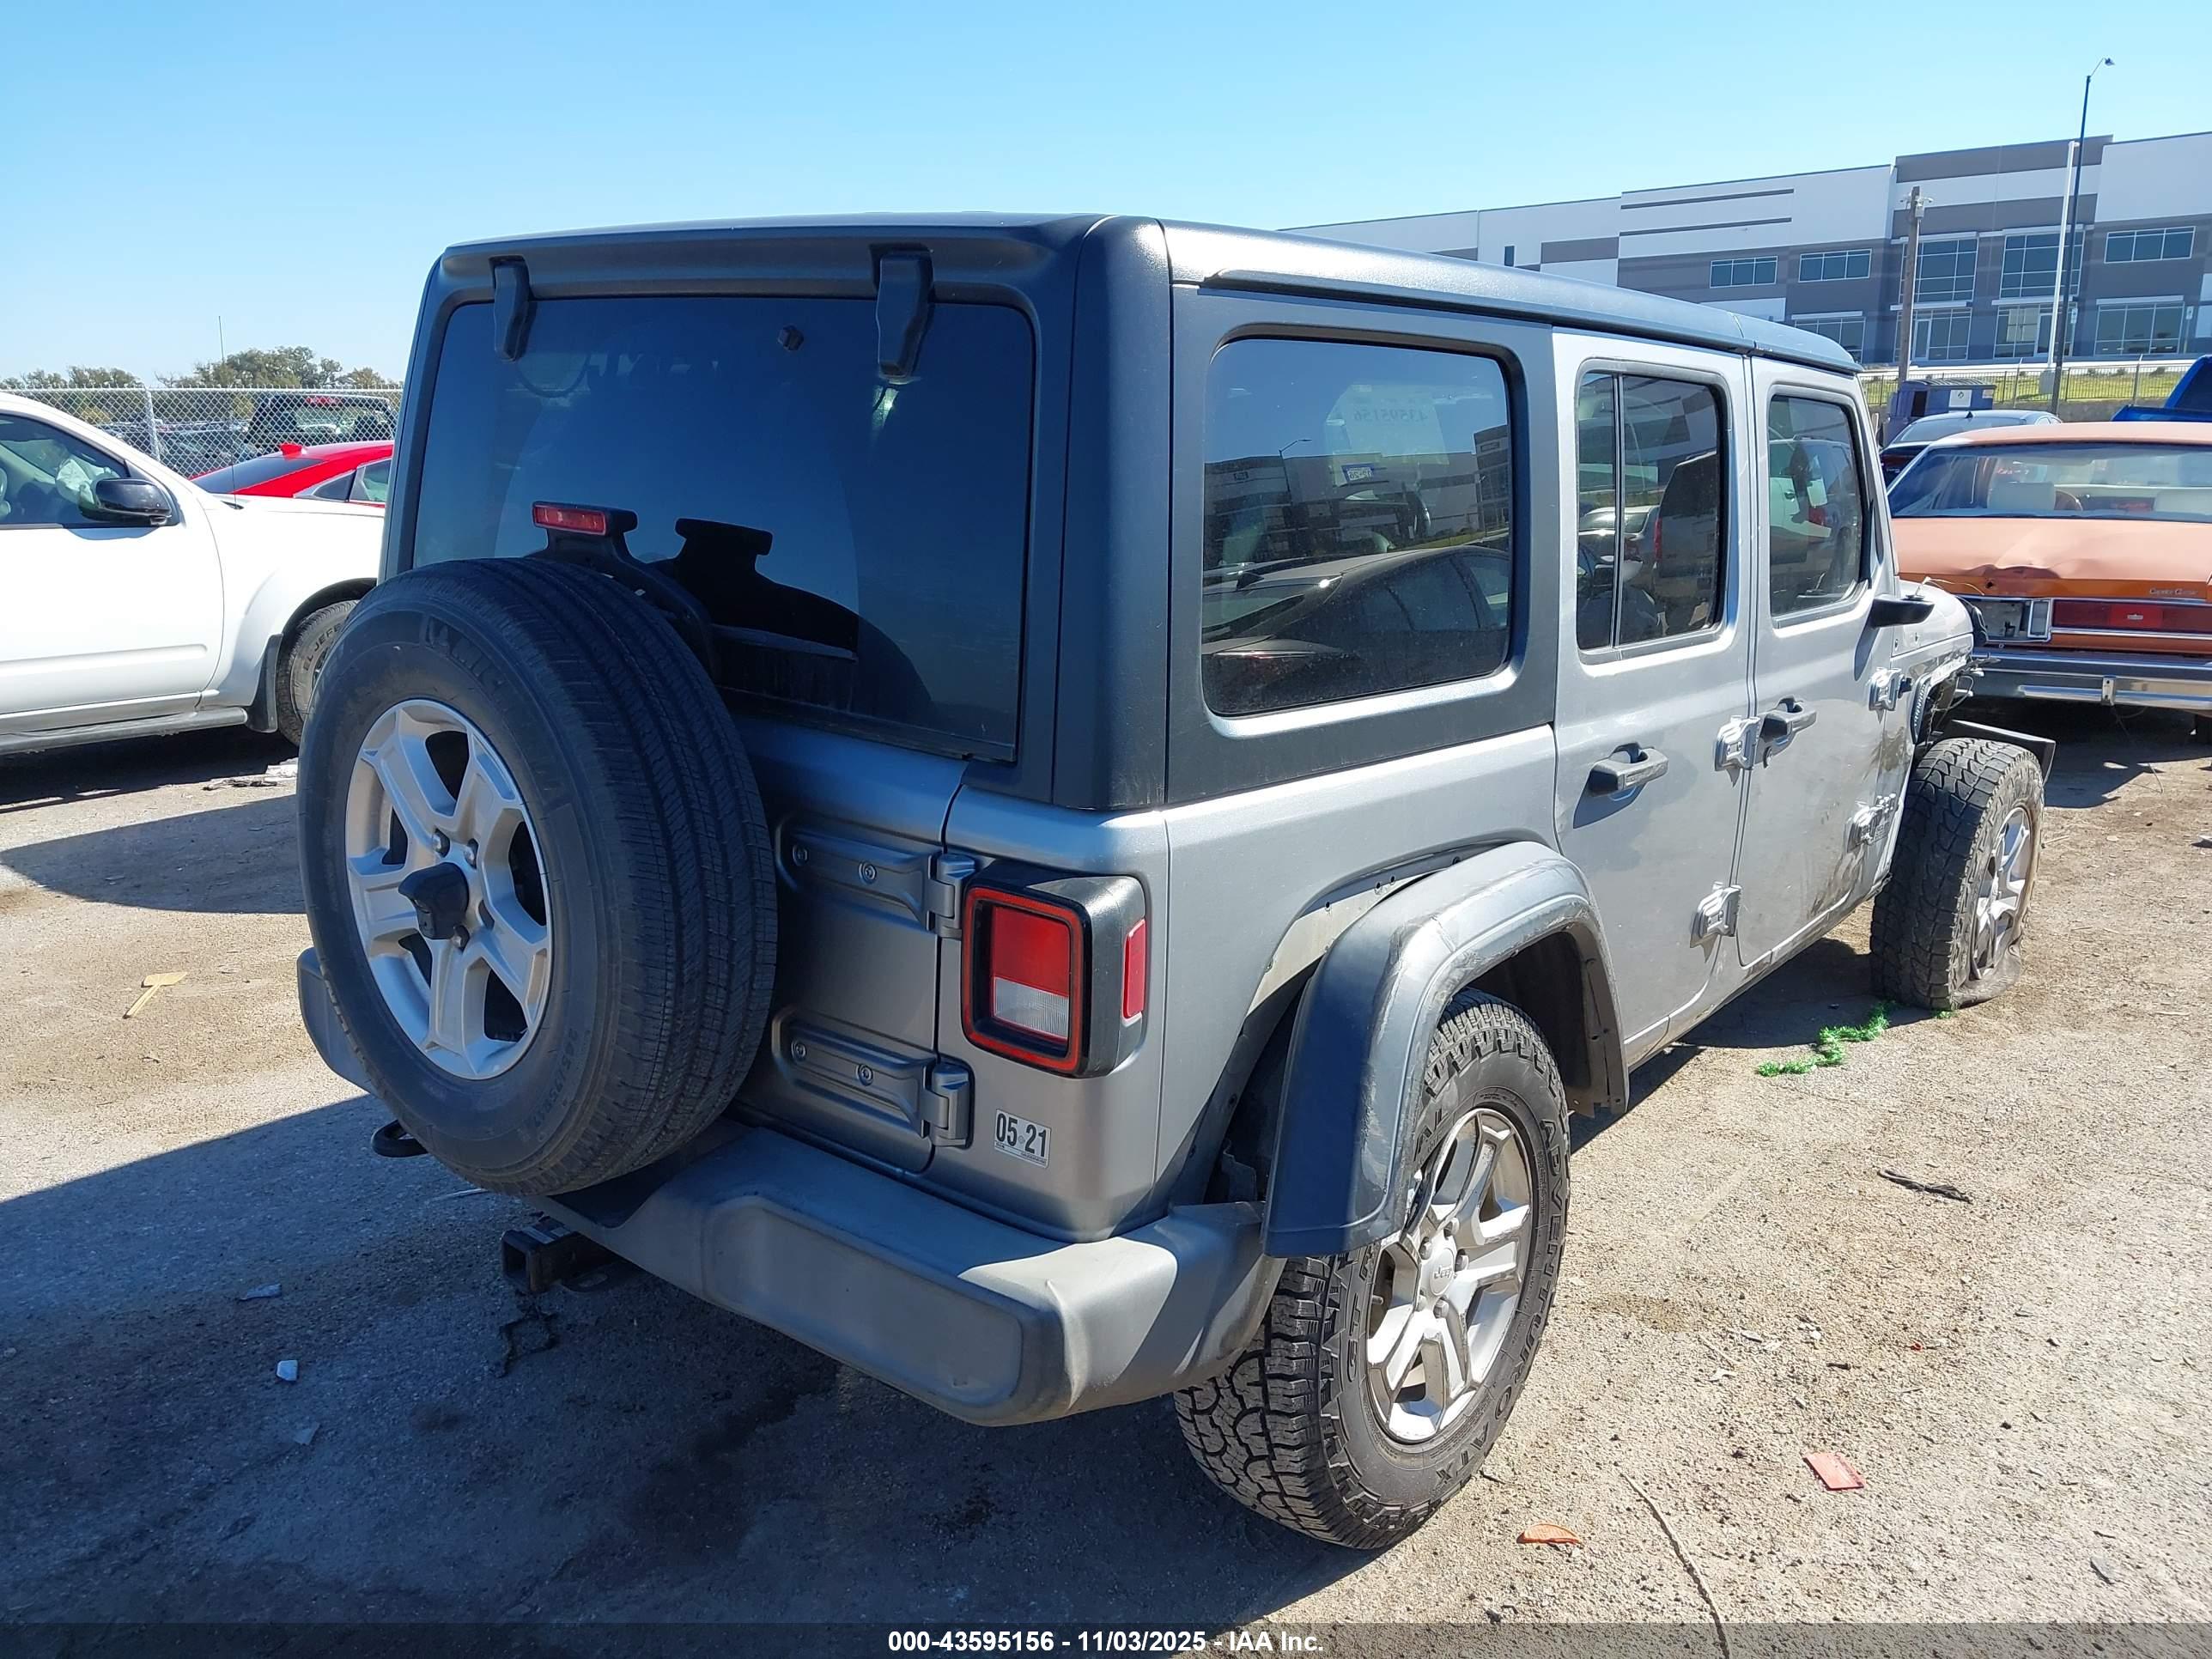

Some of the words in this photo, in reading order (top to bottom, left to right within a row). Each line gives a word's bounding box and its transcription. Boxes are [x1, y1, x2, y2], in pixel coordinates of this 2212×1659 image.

[303, 654, 314, 671] EL
[996, 1113, 1018, 1146] 05
[1024, 1124, 1047, 1158] 21
[1346, 1291, 1361, 1383] GT
[1495, 1118, 1563, 1421] ADVENTURO
[1433, 1266, 1452, 1279] Jeep
